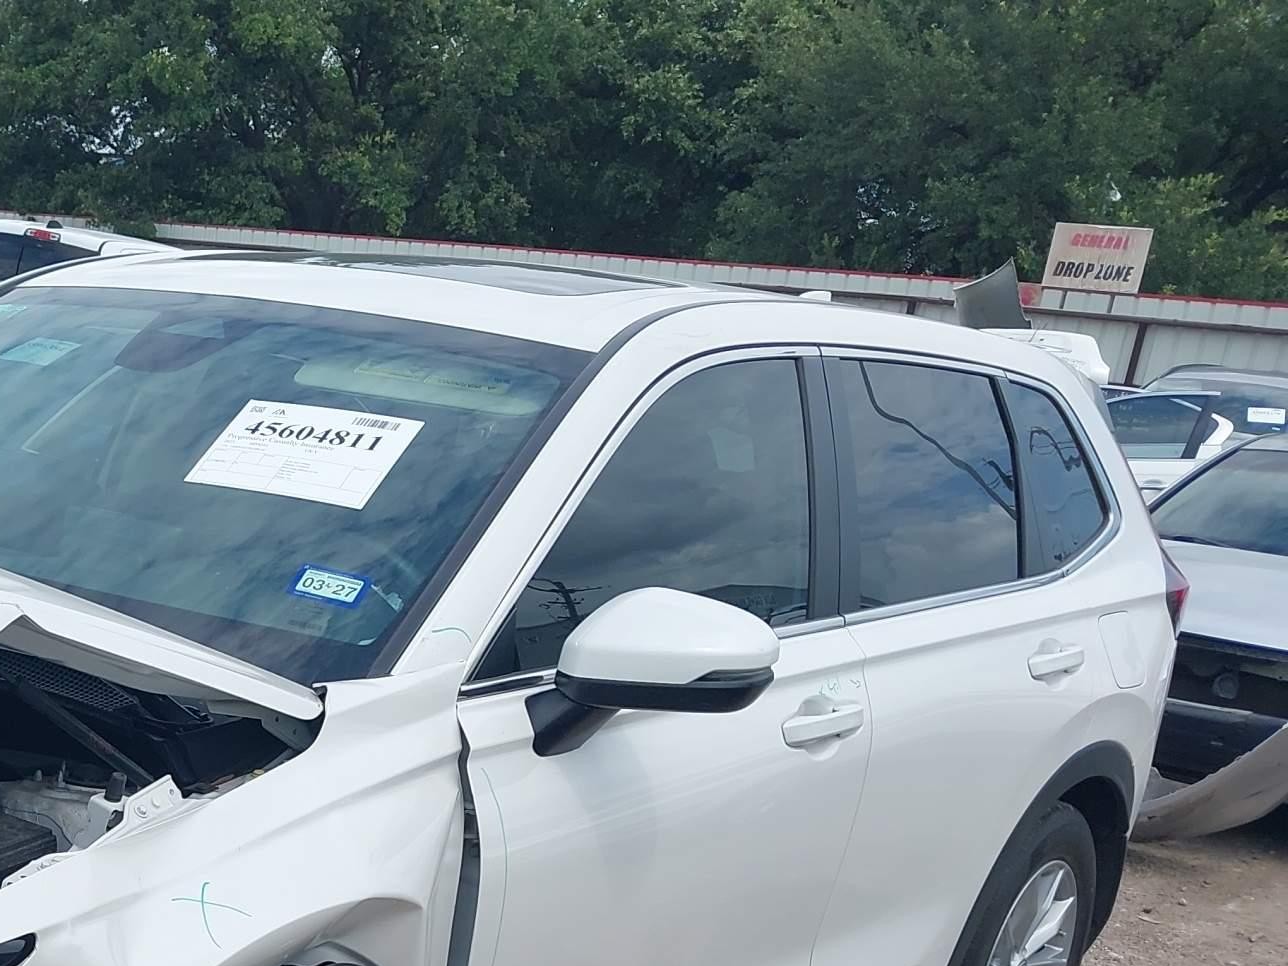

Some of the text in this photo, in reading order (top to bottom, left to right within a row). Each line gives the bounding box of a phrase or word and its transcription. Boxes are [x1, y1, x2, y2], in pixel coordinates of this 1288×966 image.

[1052, 261, 1135, 282] DROP ZONE
[244, 420, 384, 452] 45604811
[302, 577, 326, 591] 03
[331, 584, 358, 598] 27
